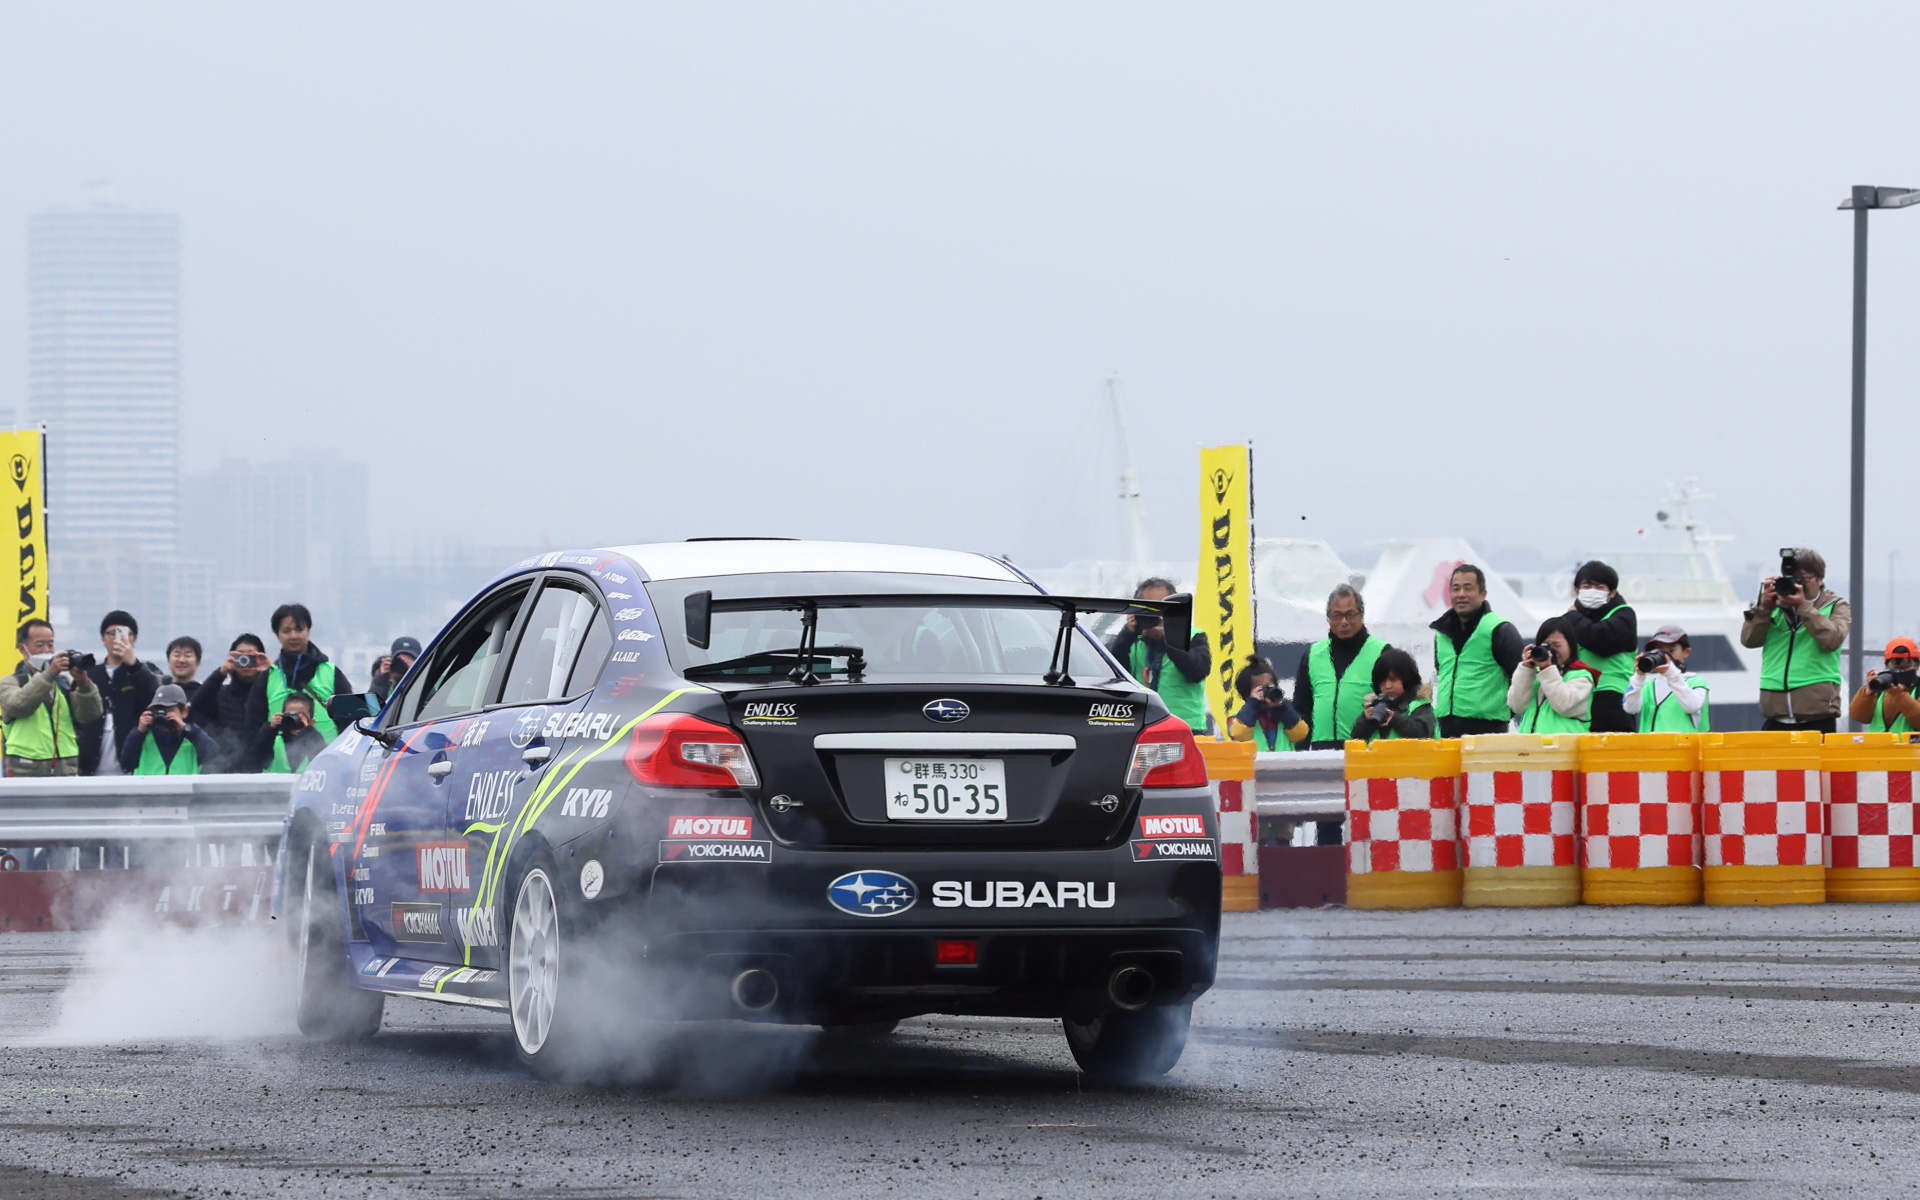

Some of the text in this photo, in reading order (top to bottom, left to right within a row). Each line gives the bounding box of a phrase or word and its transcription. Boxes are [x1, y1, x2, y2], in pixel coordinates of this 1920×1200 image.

[743, 702, 797, 717] ENDLESS
[1088, 703, 1134, 718] ENDLESS
[541, 712, 621, 740] SUBARU
[914, 763, 978, 780] 群馬 330
[464, 769, 523, 821] ENDLESS
[560, 787, 613, 818] KYB
[893, 783, 1000, 815] ね 50-35
[672, 818, 748, 836] MOTUL
[1145, 817, 1203, 835] MOTUL
[687, 844, 765, 858] YOKOHAMA
[1155, 842, 1213, 856] YOKOHAMA
[421, 847, 470, 890] MOTUL
[932, 880, 1116, 908] SUBARU
[403, 911, 443, 935] YOKOHAMA
